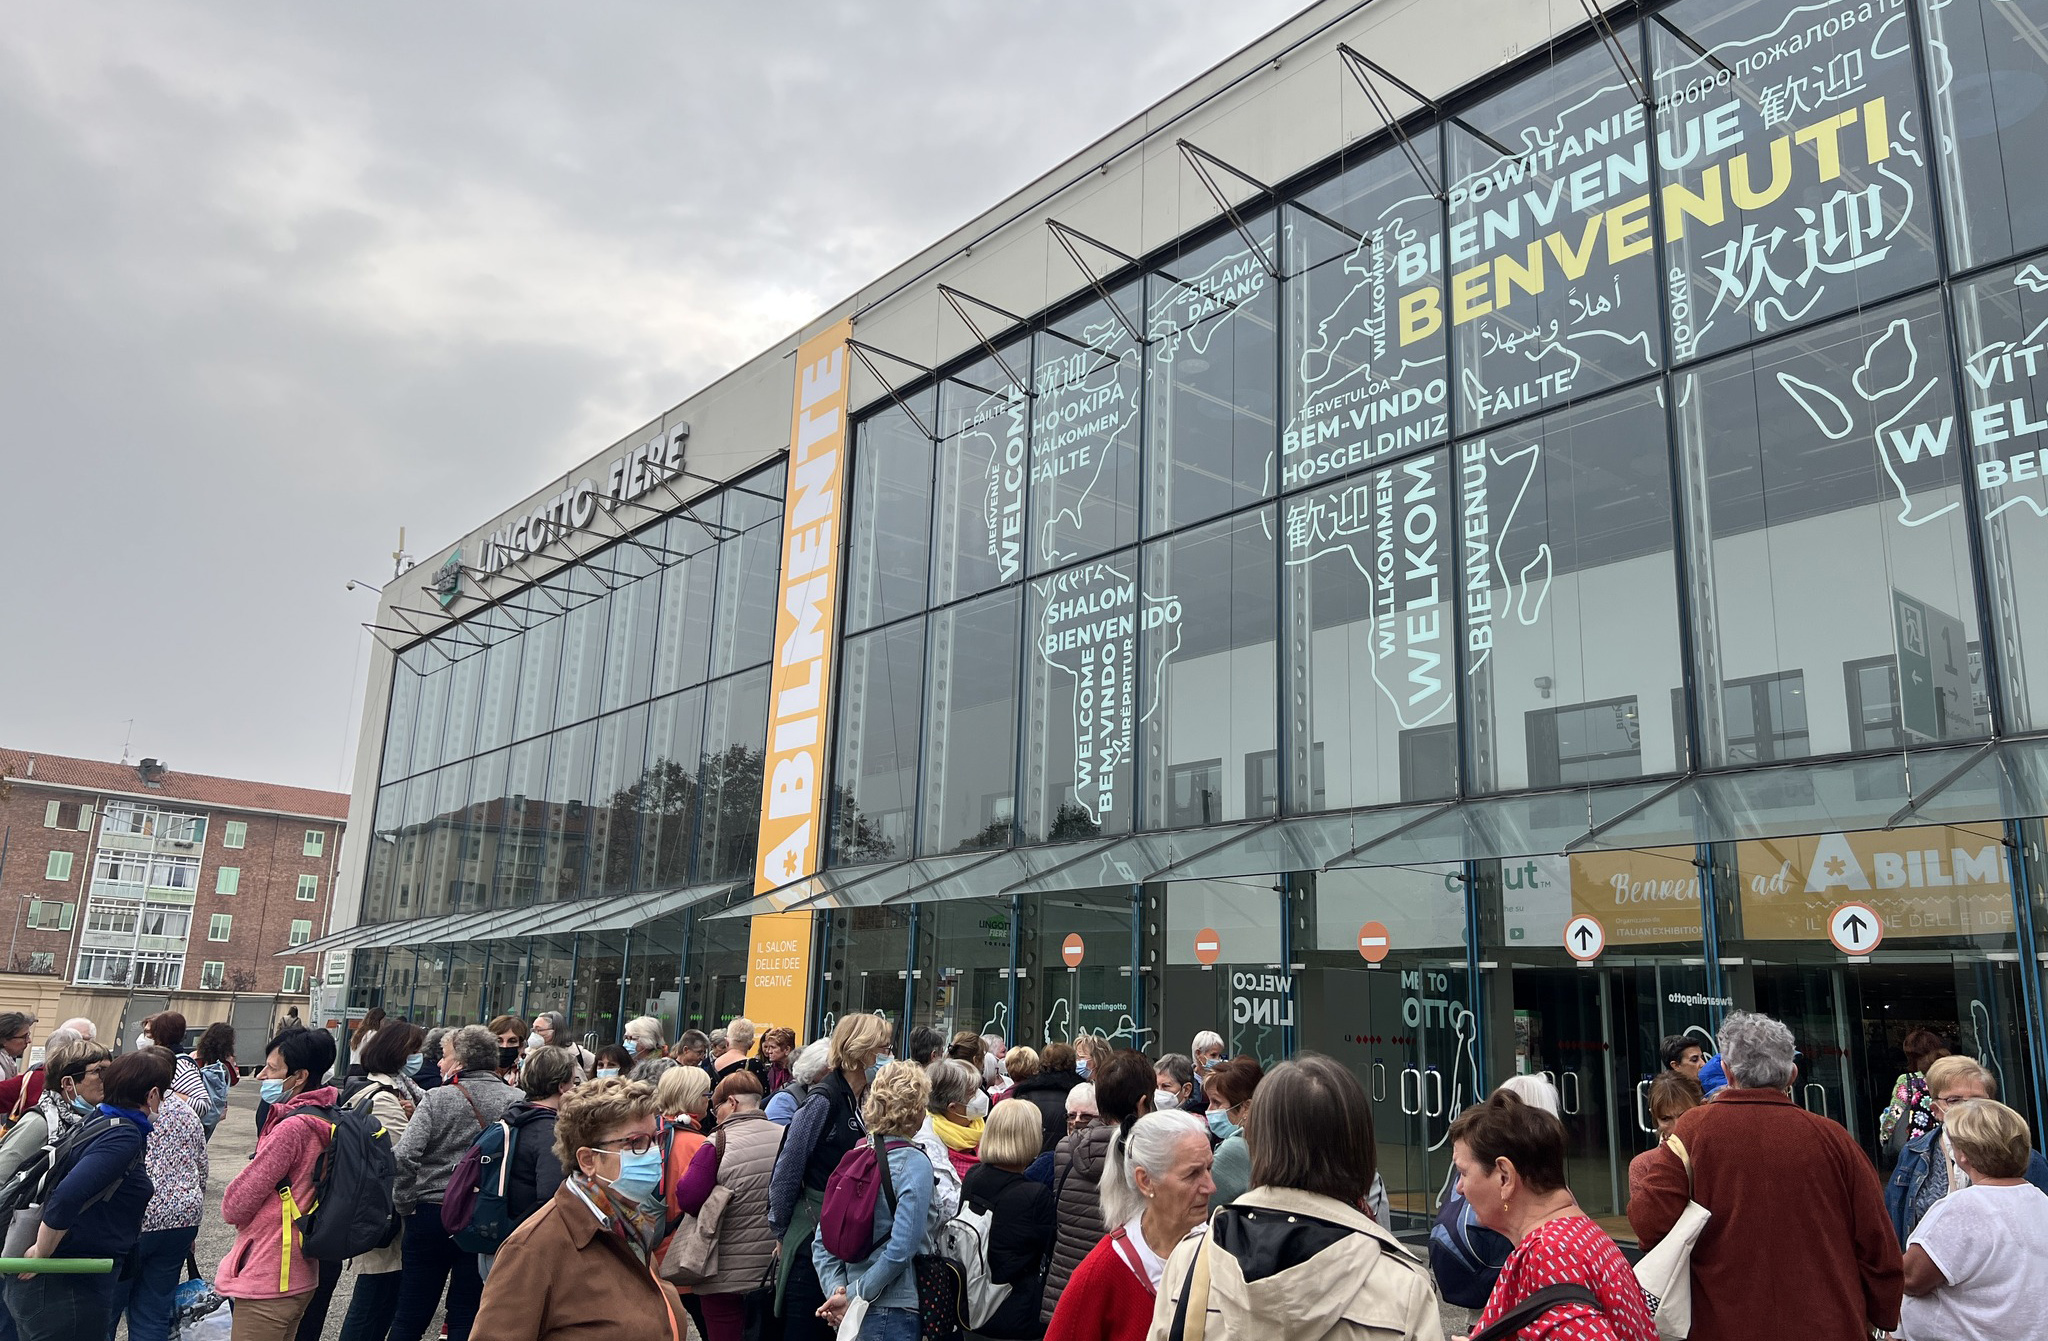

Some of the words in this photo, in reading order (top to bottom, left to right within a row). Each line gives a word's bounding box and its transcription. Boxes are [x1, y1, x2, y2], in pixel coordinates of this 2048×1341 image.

[1656, 68, 1731, 118] добро
[1449, 107, 1647, 215] POWITANIE
[1399, 99, 1744, 287] BIENVENUE
[1400, 96, 1890, 347] BENVENUTI
[1700, 183, 1892, 322] 欢迎
[1188, 272, 1265, 322] DATANG
[1372, 227, 1386, 361] WILLKOMMEN
[1965, 342, 2048, 389] VÍT
[1282, 378, 1447, 456] BEM-VINDO
[1298, 379, 1391, 420] TERVETULOA
[1478, 367, 1573, 420] FÁILTE
[1033, 411, 1119, 458] VÄLKOMMEN
[1282, 415, 1449, 486] HOSGELDINIZ
[1000, 378, 1027, 583] WELCOME
[1031, 445, 1090, 486] FÁILTE
[475, 478, 598, 583] LINGOTTO
[606, 421, 690, 512] FIERE
[988, 463, 1001, 556] BIENVENUE
[1376, 469, 1396, 660] WILLKOMMEN
[1462, 439, 1493, 652] BIENVENUE
[1048, 582, 1135, 625] SHALOM
[1403, 455, 1442, 707] WELKOM
[764, 347, 843, 905] ABILMENTE
[1078, 647, 1095, 789] WELCOME
[1099, 643, 1116, 812] BEM-VINDO
[1609, 873, 1700, 905] Benven
[1751, 859, 1790, 895] ad
[1804, 833, 2010, 893] ABILM
[979, 919, 1011, 930] LINGOTT
[988, 929, 1008, 938] FIERE
[1616, 928, 1652, 937] ITALIAN
[1909, 913, 1972, 929] DELLE
[1979, 911, 2012, 925] IDE
[755, 958, 780, 970] DELLE
[782, 957, 800, 970] IDEE
[757, 943, 764, 954] IL
[766, 940, 798, 953] SALONE
[754, 975, 792, 987] CREATIVE
[1428, 973, 1448, 993] TO
[1079, 1002, 1127, 1012] #wearelingotto
[1403, 997, 1465, 1030] OTTO
